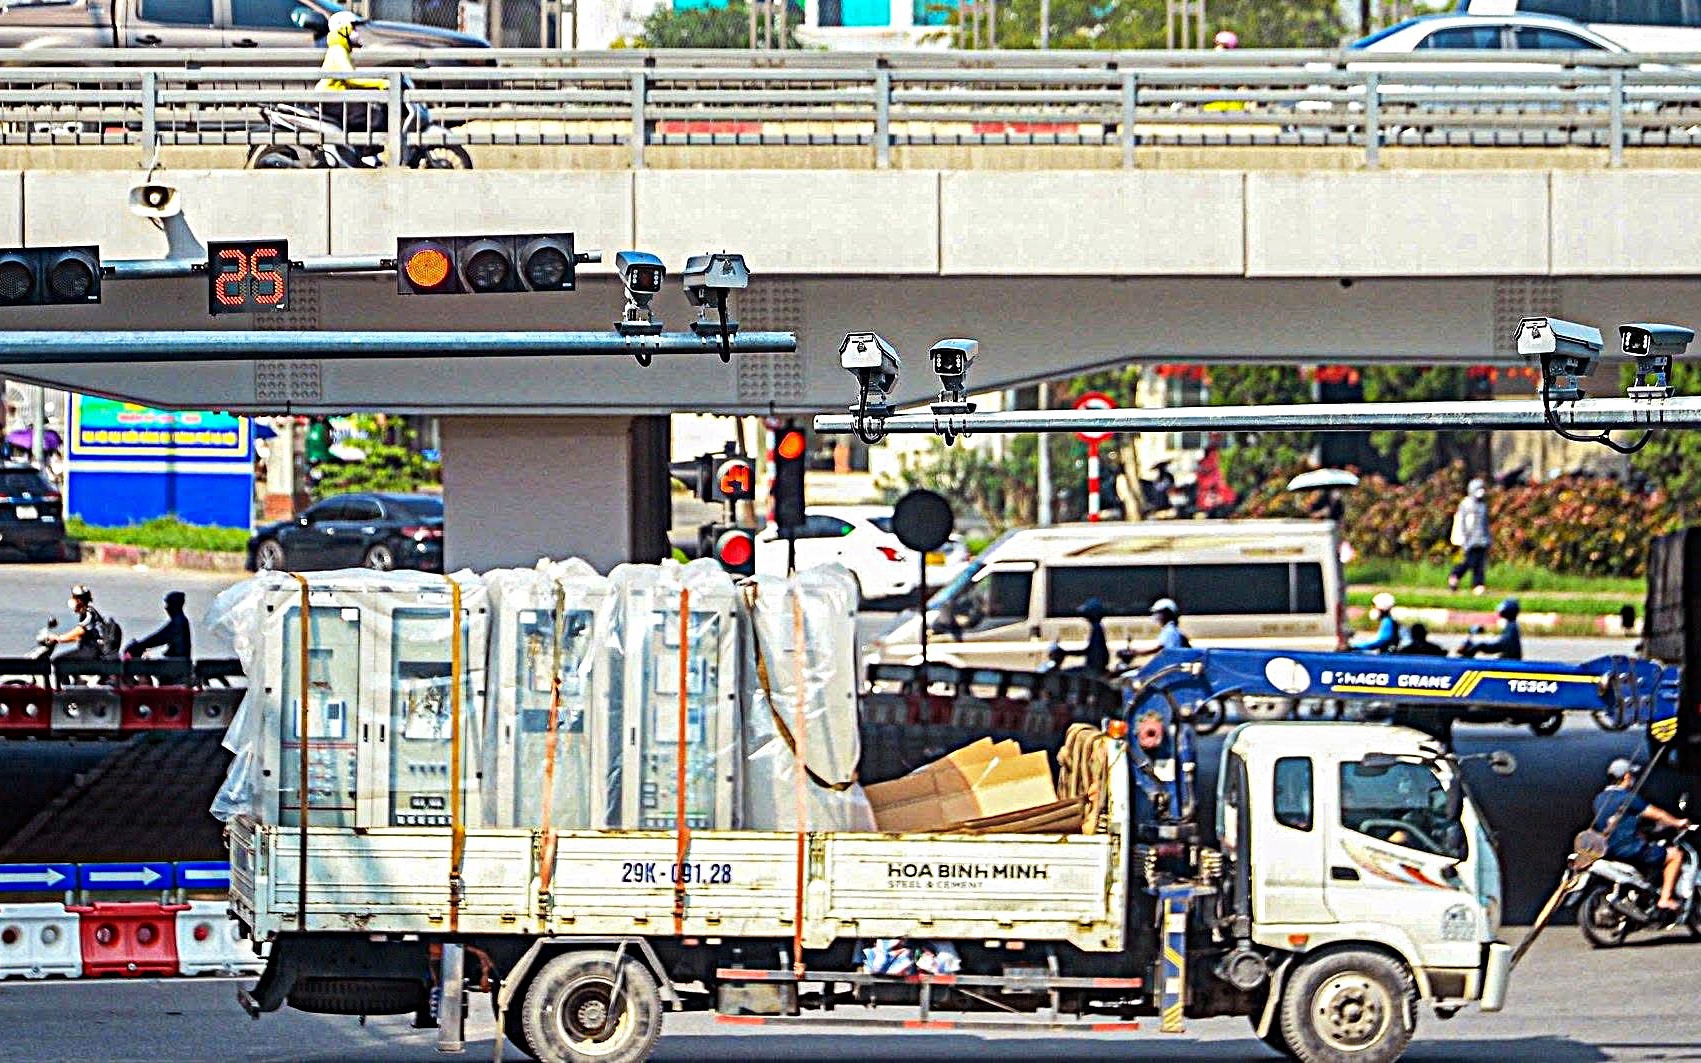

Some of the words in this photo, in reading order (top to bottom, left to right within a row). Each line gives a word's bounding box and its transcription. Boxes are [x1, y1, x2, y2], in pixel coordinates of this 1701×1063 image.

[215, 248, 284, 305] 25
[1397, 675, 1451, 689] CRANE
[888, 863, 933, 878] HOA
[938, 864, 988, 879] BINH
[993, 864, 1048, 879] MINH
[888, 880, 922, 889] STEEL
[936, 881, 984, 889] CEMENT
